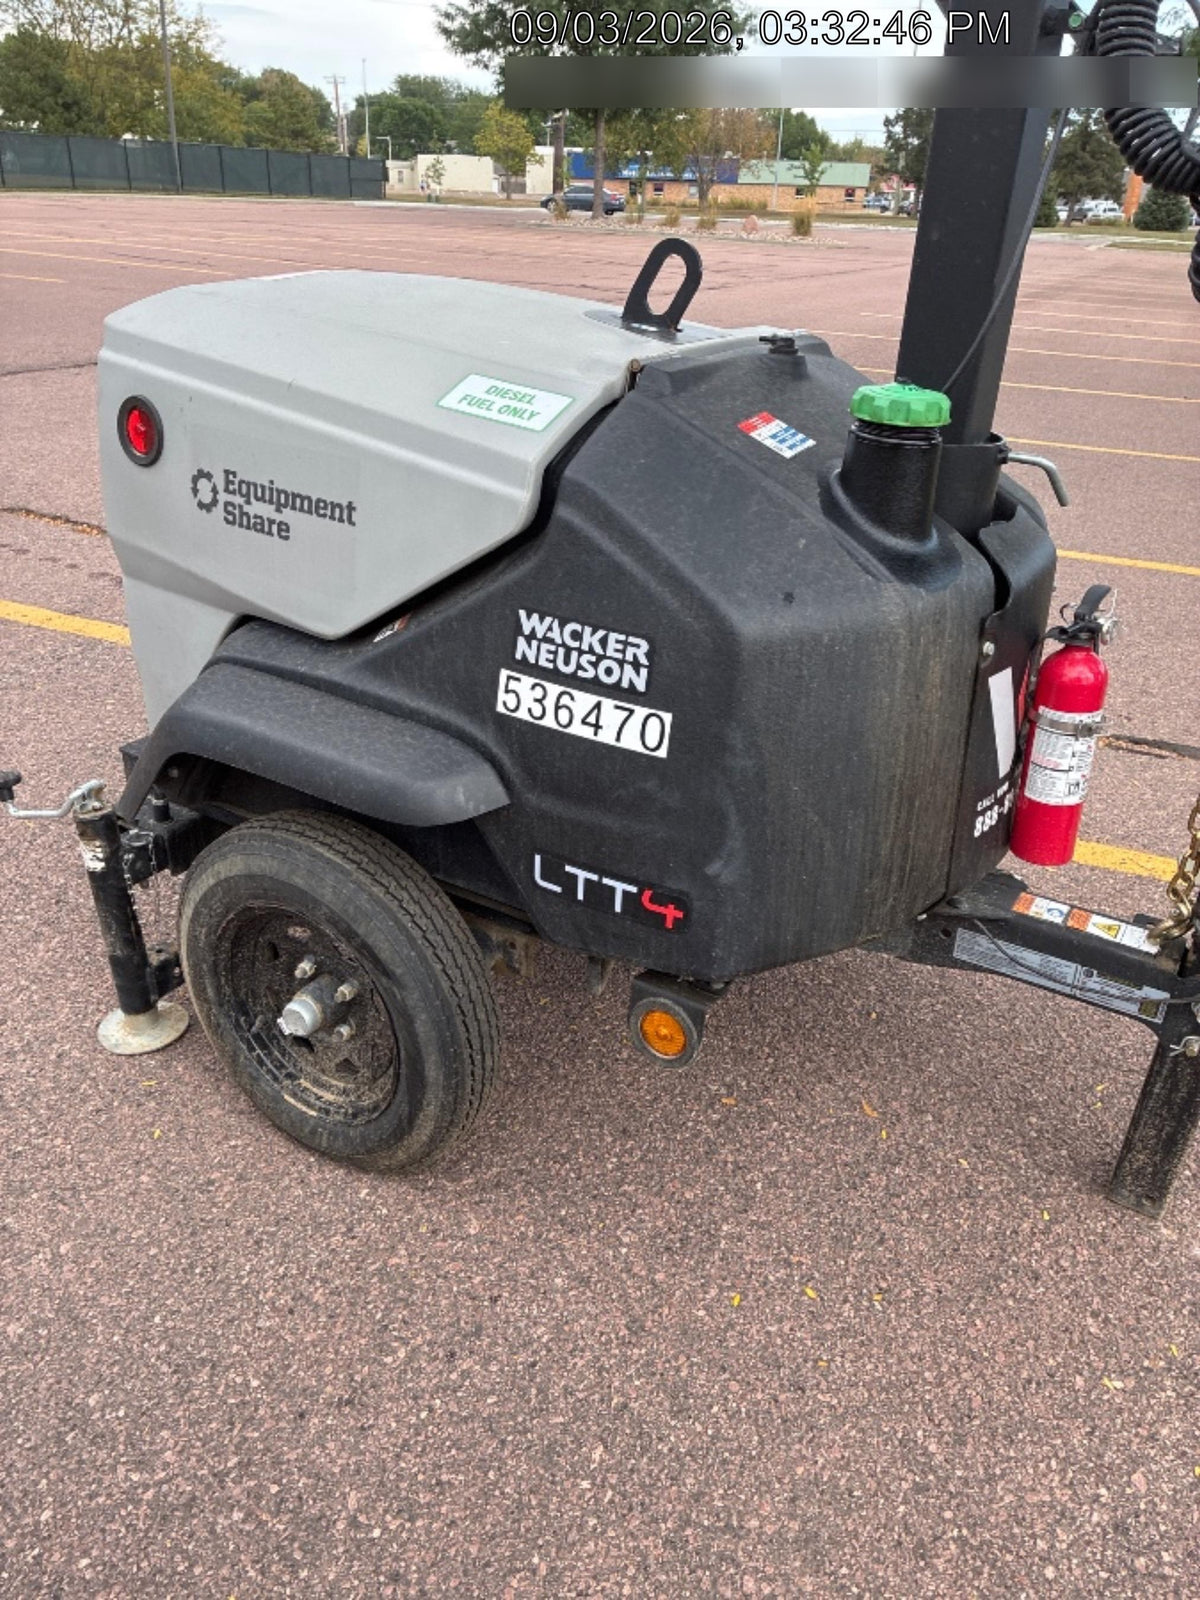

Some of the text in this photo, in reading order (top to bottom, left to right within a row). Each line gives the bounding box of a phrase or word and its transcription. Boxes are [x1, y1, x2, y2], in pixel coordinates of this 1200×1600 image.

[458, 394, 541, 421] FUEL ONLY
[485, 385, 537, 405] DIESEL
[223, 468, 357, 527] Equipment
[223, 500, 291, 541] Share
[515, 636, 649, 693] NEUSON
[518, 609, 650, 666] WACKER
[502, 674, 666, 752] 536470
[534, 854, 684, 929] LTT4
